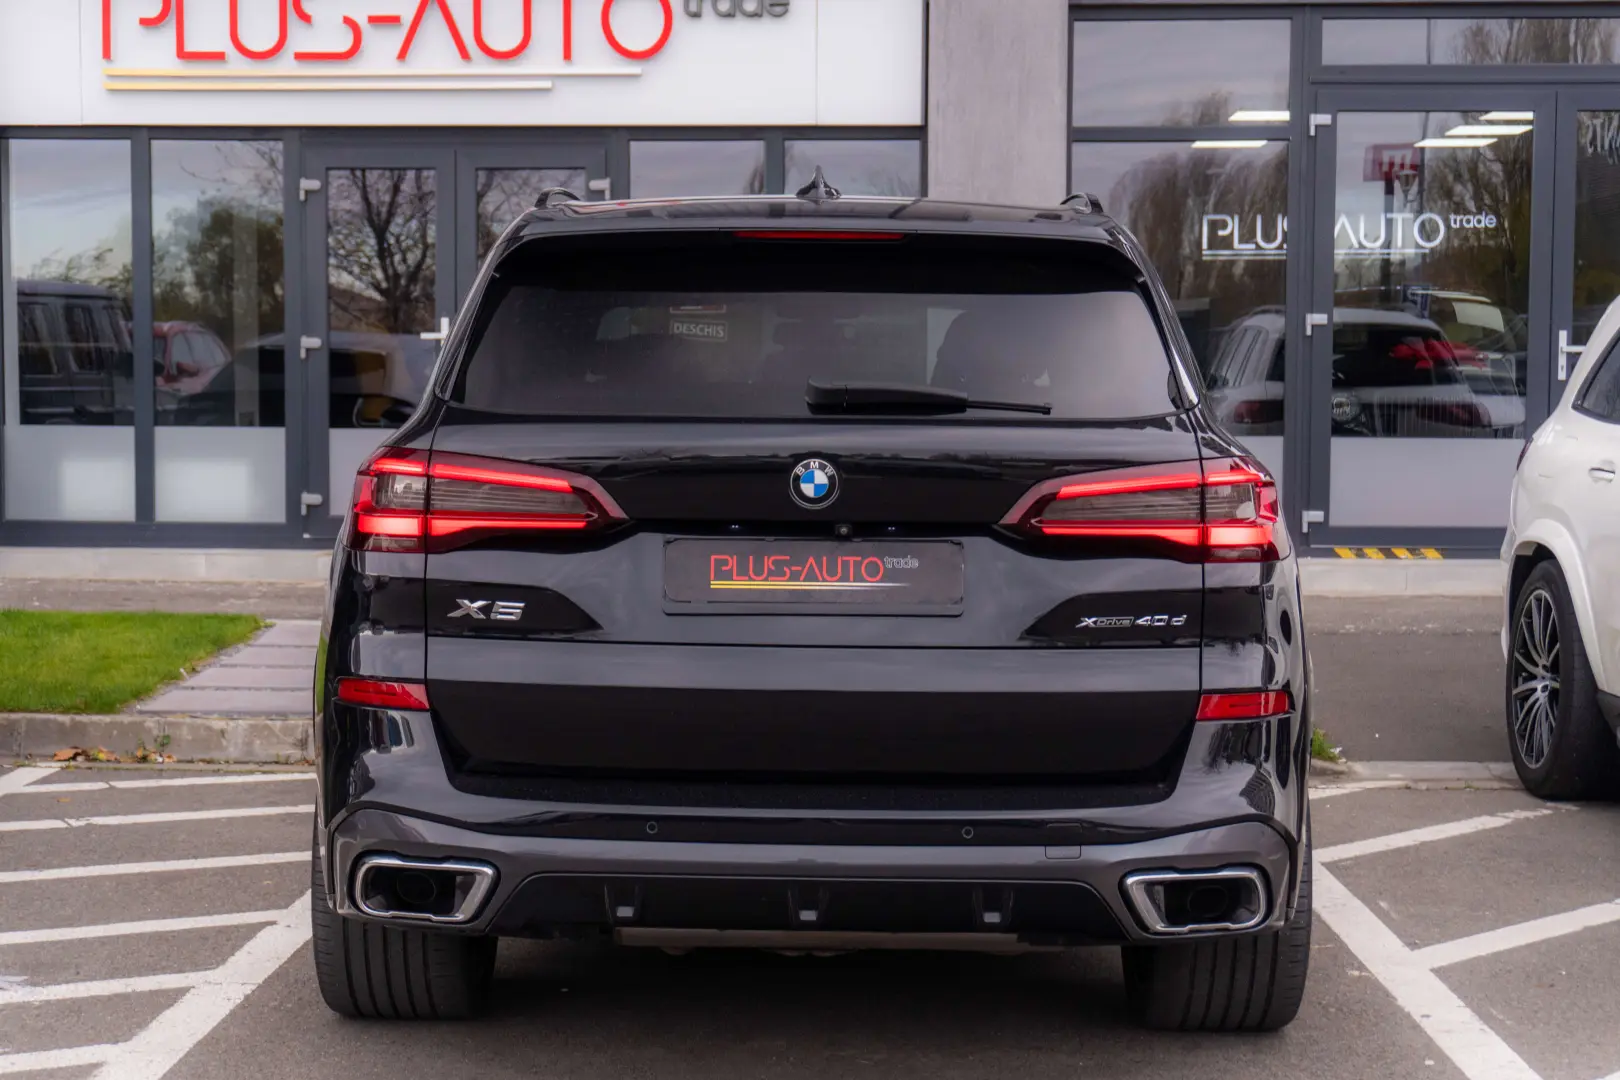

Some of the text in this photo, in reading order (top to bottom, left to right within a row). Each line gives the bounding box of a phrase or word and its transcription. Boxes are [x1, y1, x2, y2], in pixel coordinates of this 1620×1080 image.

[1449, 211, 1497, 229] trade
[673, 322, 724, 338] DESCHIS
[795, 460, 834, 477] BMW
[710, 554, 919, 582] PLUS-AUTO trade
[446, 598, 527, 621] X5
